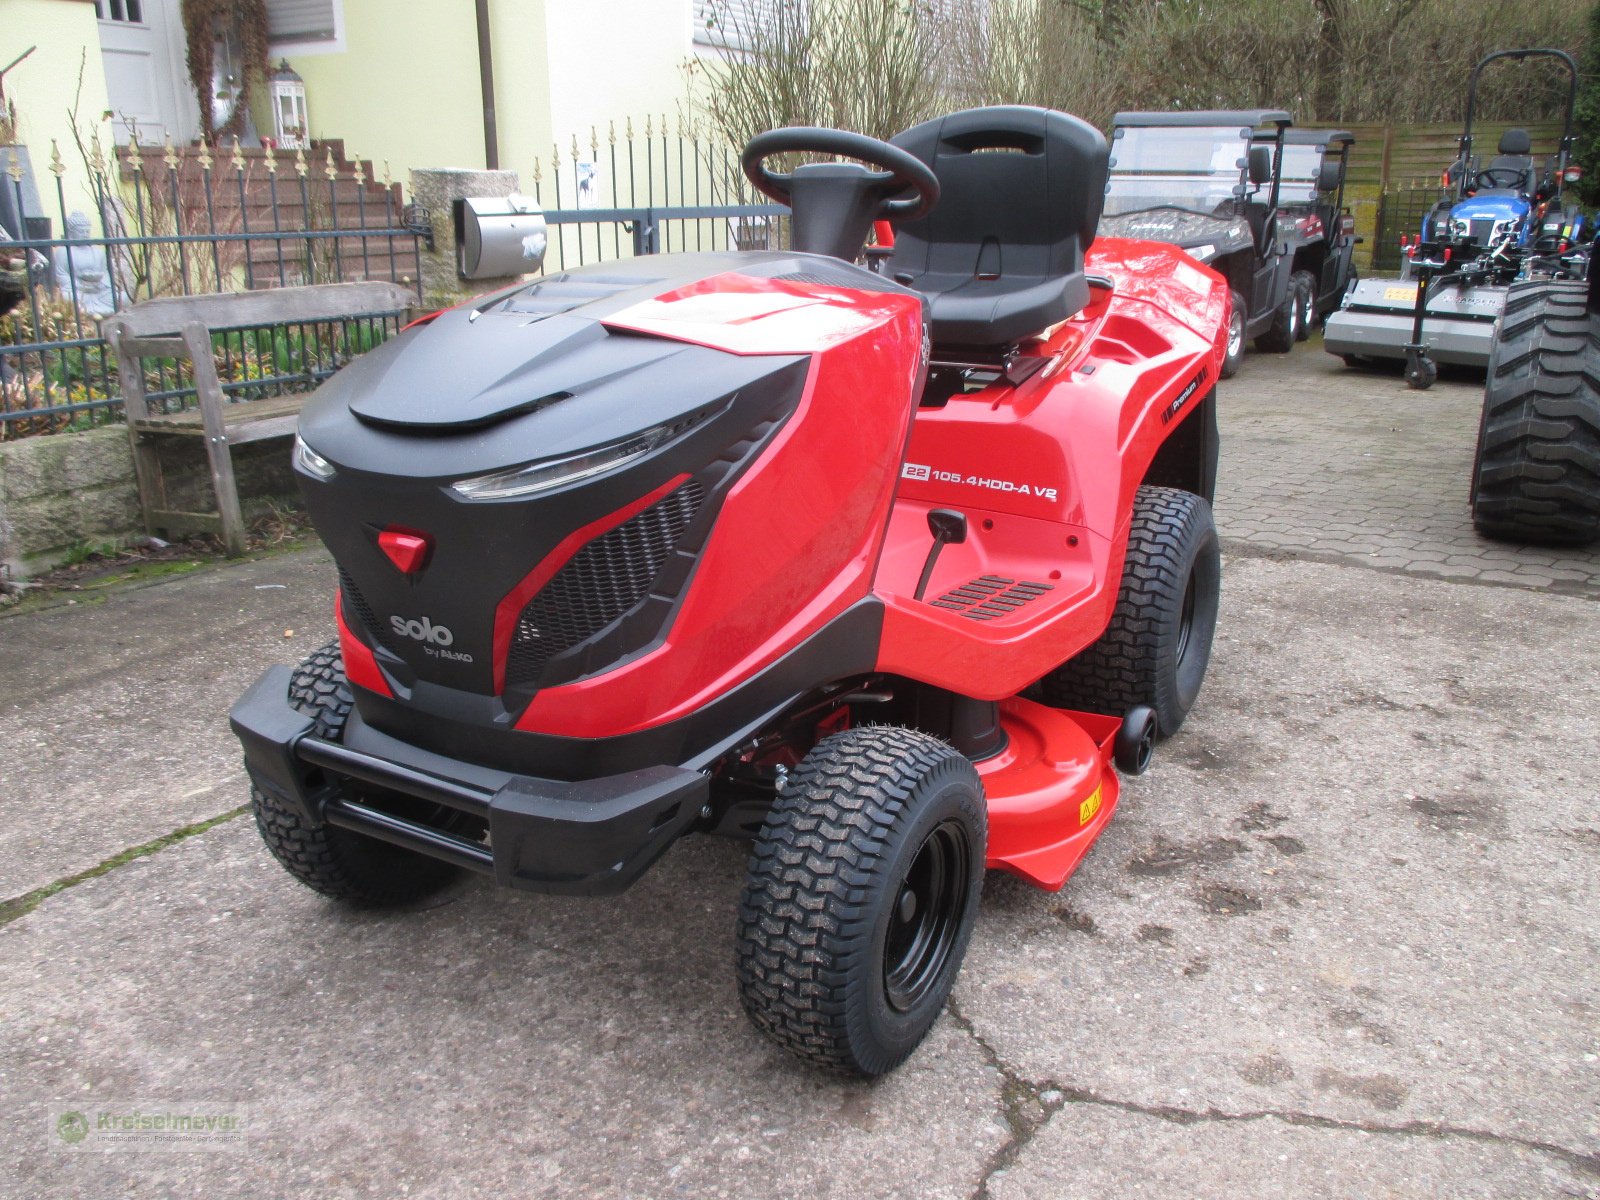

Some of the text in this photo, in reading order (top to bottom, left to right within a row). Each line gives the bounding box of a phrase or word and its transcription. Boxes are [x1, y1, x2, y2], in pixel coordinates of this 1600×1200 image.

[1172, 382, 1197, 411] Premium
[1034, 486, 1058, 499] V2
[423, 645, 440, 658] by
